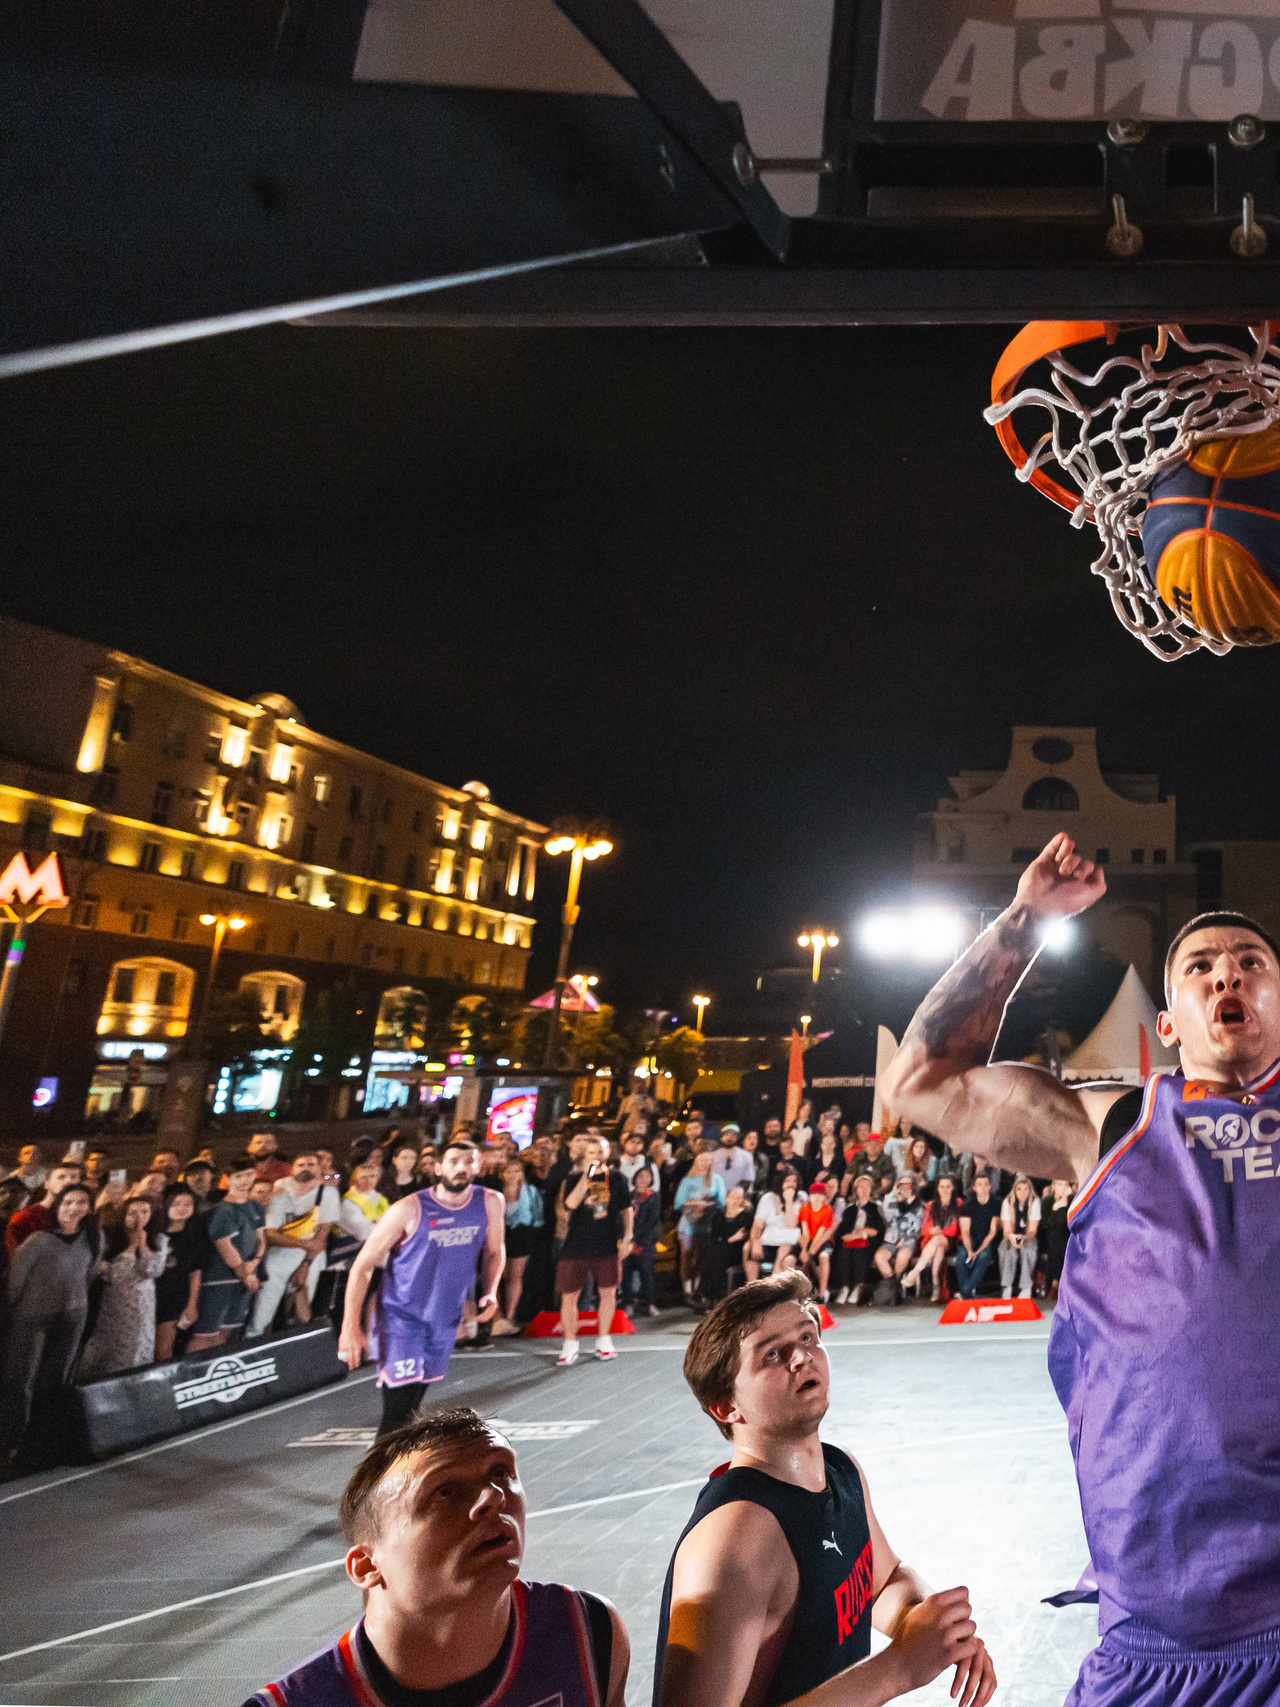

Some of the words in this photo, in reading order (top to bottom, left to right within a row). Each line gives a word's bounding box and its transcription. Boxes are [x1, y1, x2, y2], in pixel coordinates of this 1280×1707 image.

[175, 1363, 277, 1402] STREETBASKET
[394, 1358, 416, 1378] 32
[834, 1536, 873, 1645] RUSS
